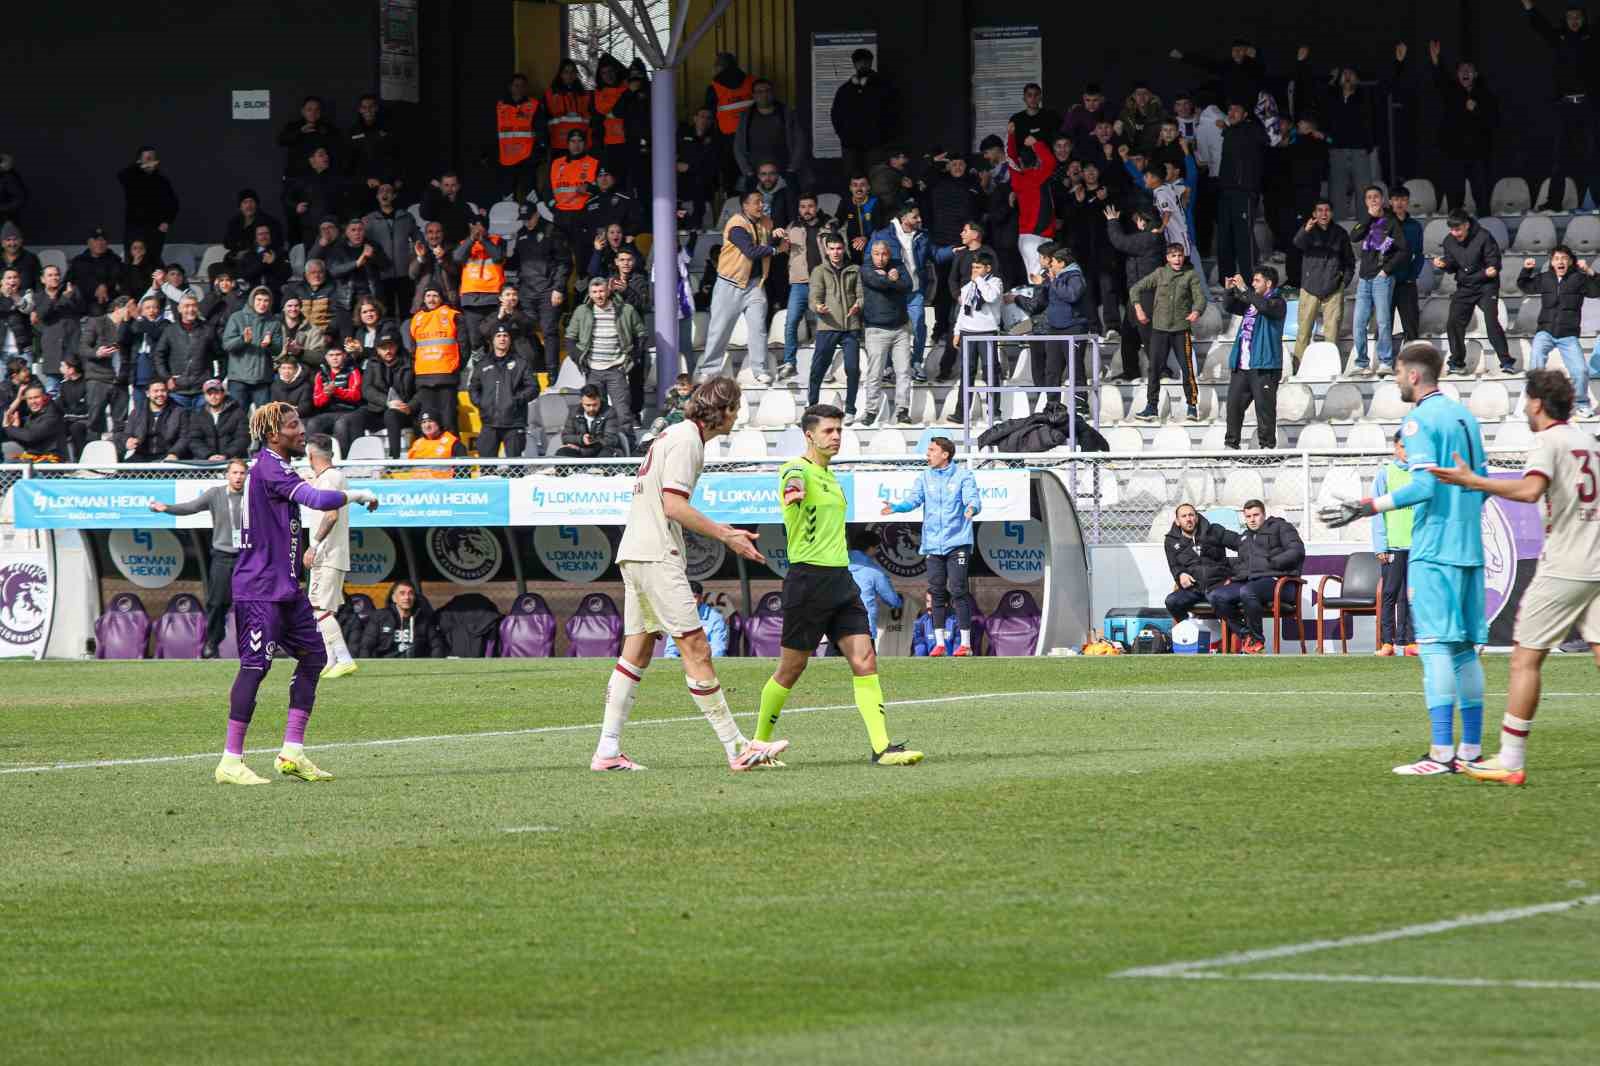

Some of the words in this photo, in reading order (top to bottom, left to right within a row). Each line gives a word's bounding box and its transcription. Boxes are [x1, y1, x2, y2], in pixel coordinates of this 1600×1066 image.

[1569, 449, 1600, 503] 3
[48, 495, 109, 508] LOKMAN
[379, 492, 441, 505] LOKMAN
[548, 492, 609, 504] LOKMAN
[719, 488, 780, 503] LOKMAN
[121, 555, 177, 565] LOKMAN
[546, 551, 604, 561] LOKMAN
[990, 549, 1046, 560] LOKMAN
